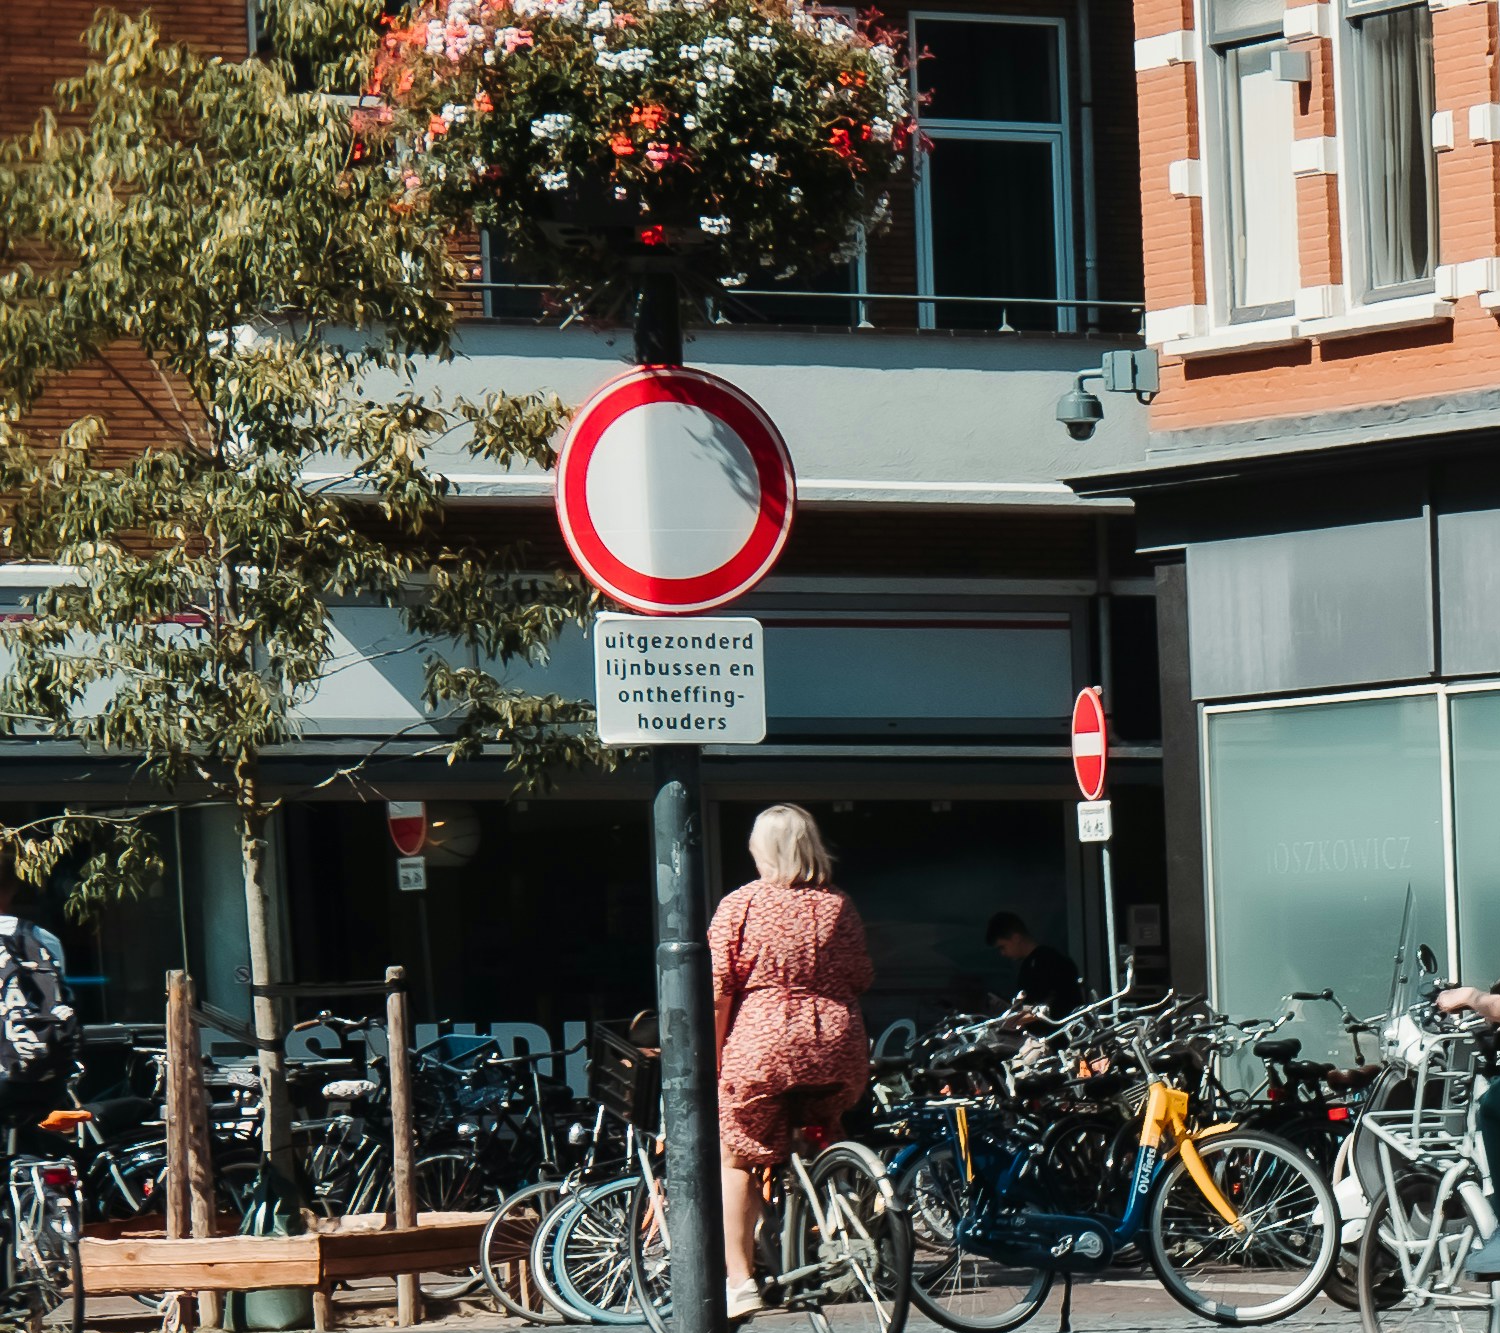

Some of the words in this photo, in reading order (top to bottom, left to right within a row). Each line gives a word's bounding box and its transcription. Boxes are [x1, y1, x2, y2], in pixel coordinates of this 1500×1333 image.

[604, 632, 754, 653] uitgezonderd
[605, 659, 721, 680] lijnbussen
[729, 663, 755, 677] en
[618, 686, 745, 707] ontheffing-
[637, 713, 727, 730] houders
[1268, 835, 1412, 875] OSZKOWICZ
